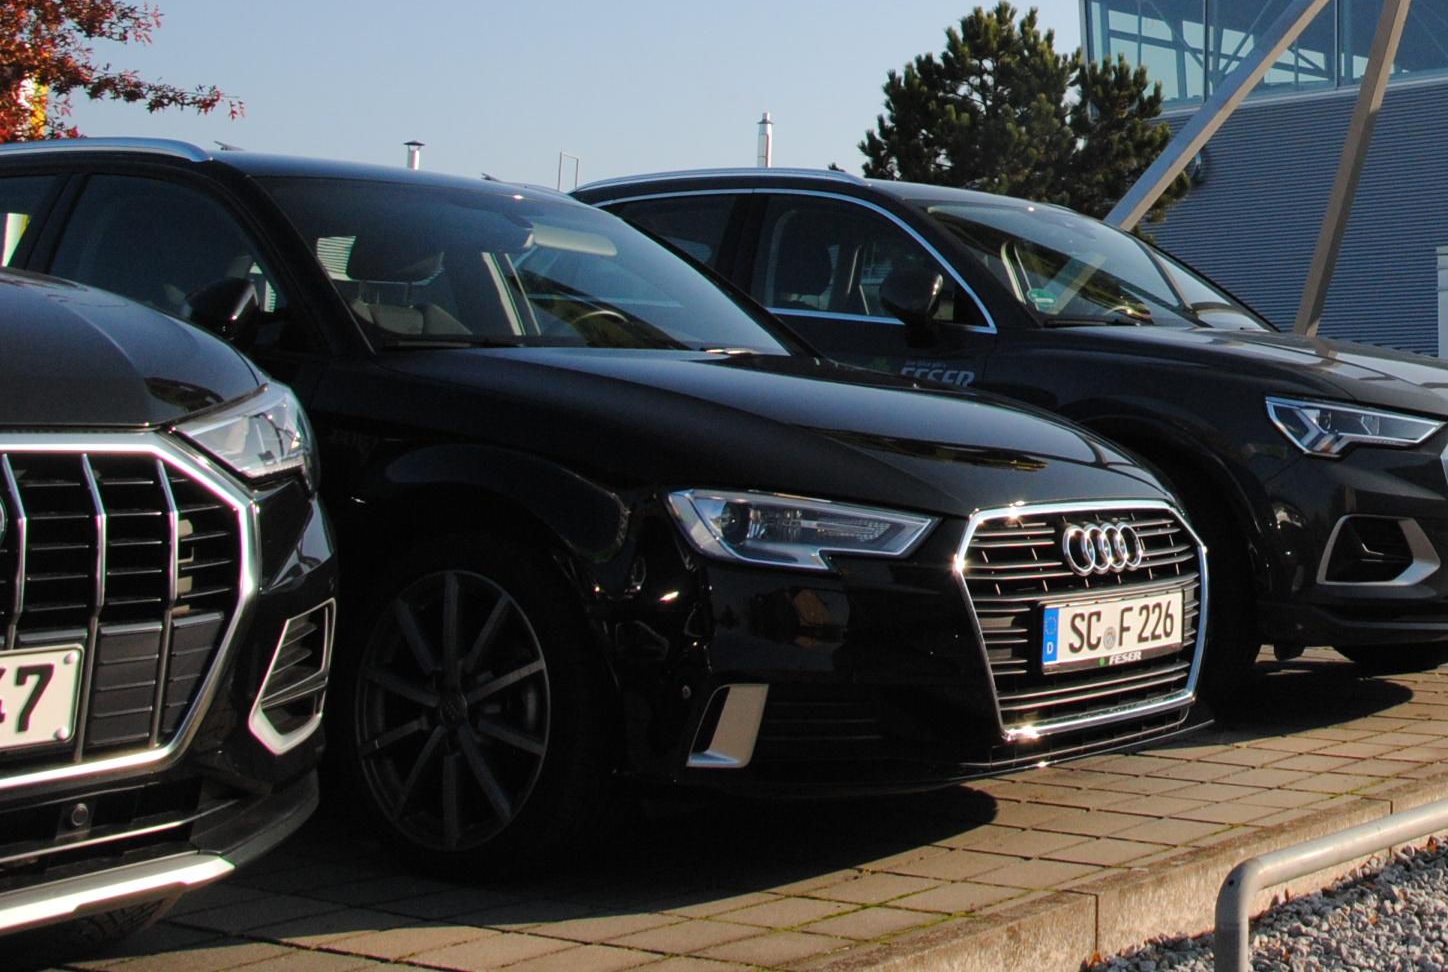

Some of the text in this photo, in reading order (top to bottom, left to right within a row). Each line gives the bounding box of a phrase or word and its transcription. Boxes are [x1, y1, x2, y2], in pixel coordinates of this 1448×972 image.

[1069, 600, 1175, 653] SC F 226
[1108, 651, 1142, 666] FESER
[0, 663, 54, 733] 7
